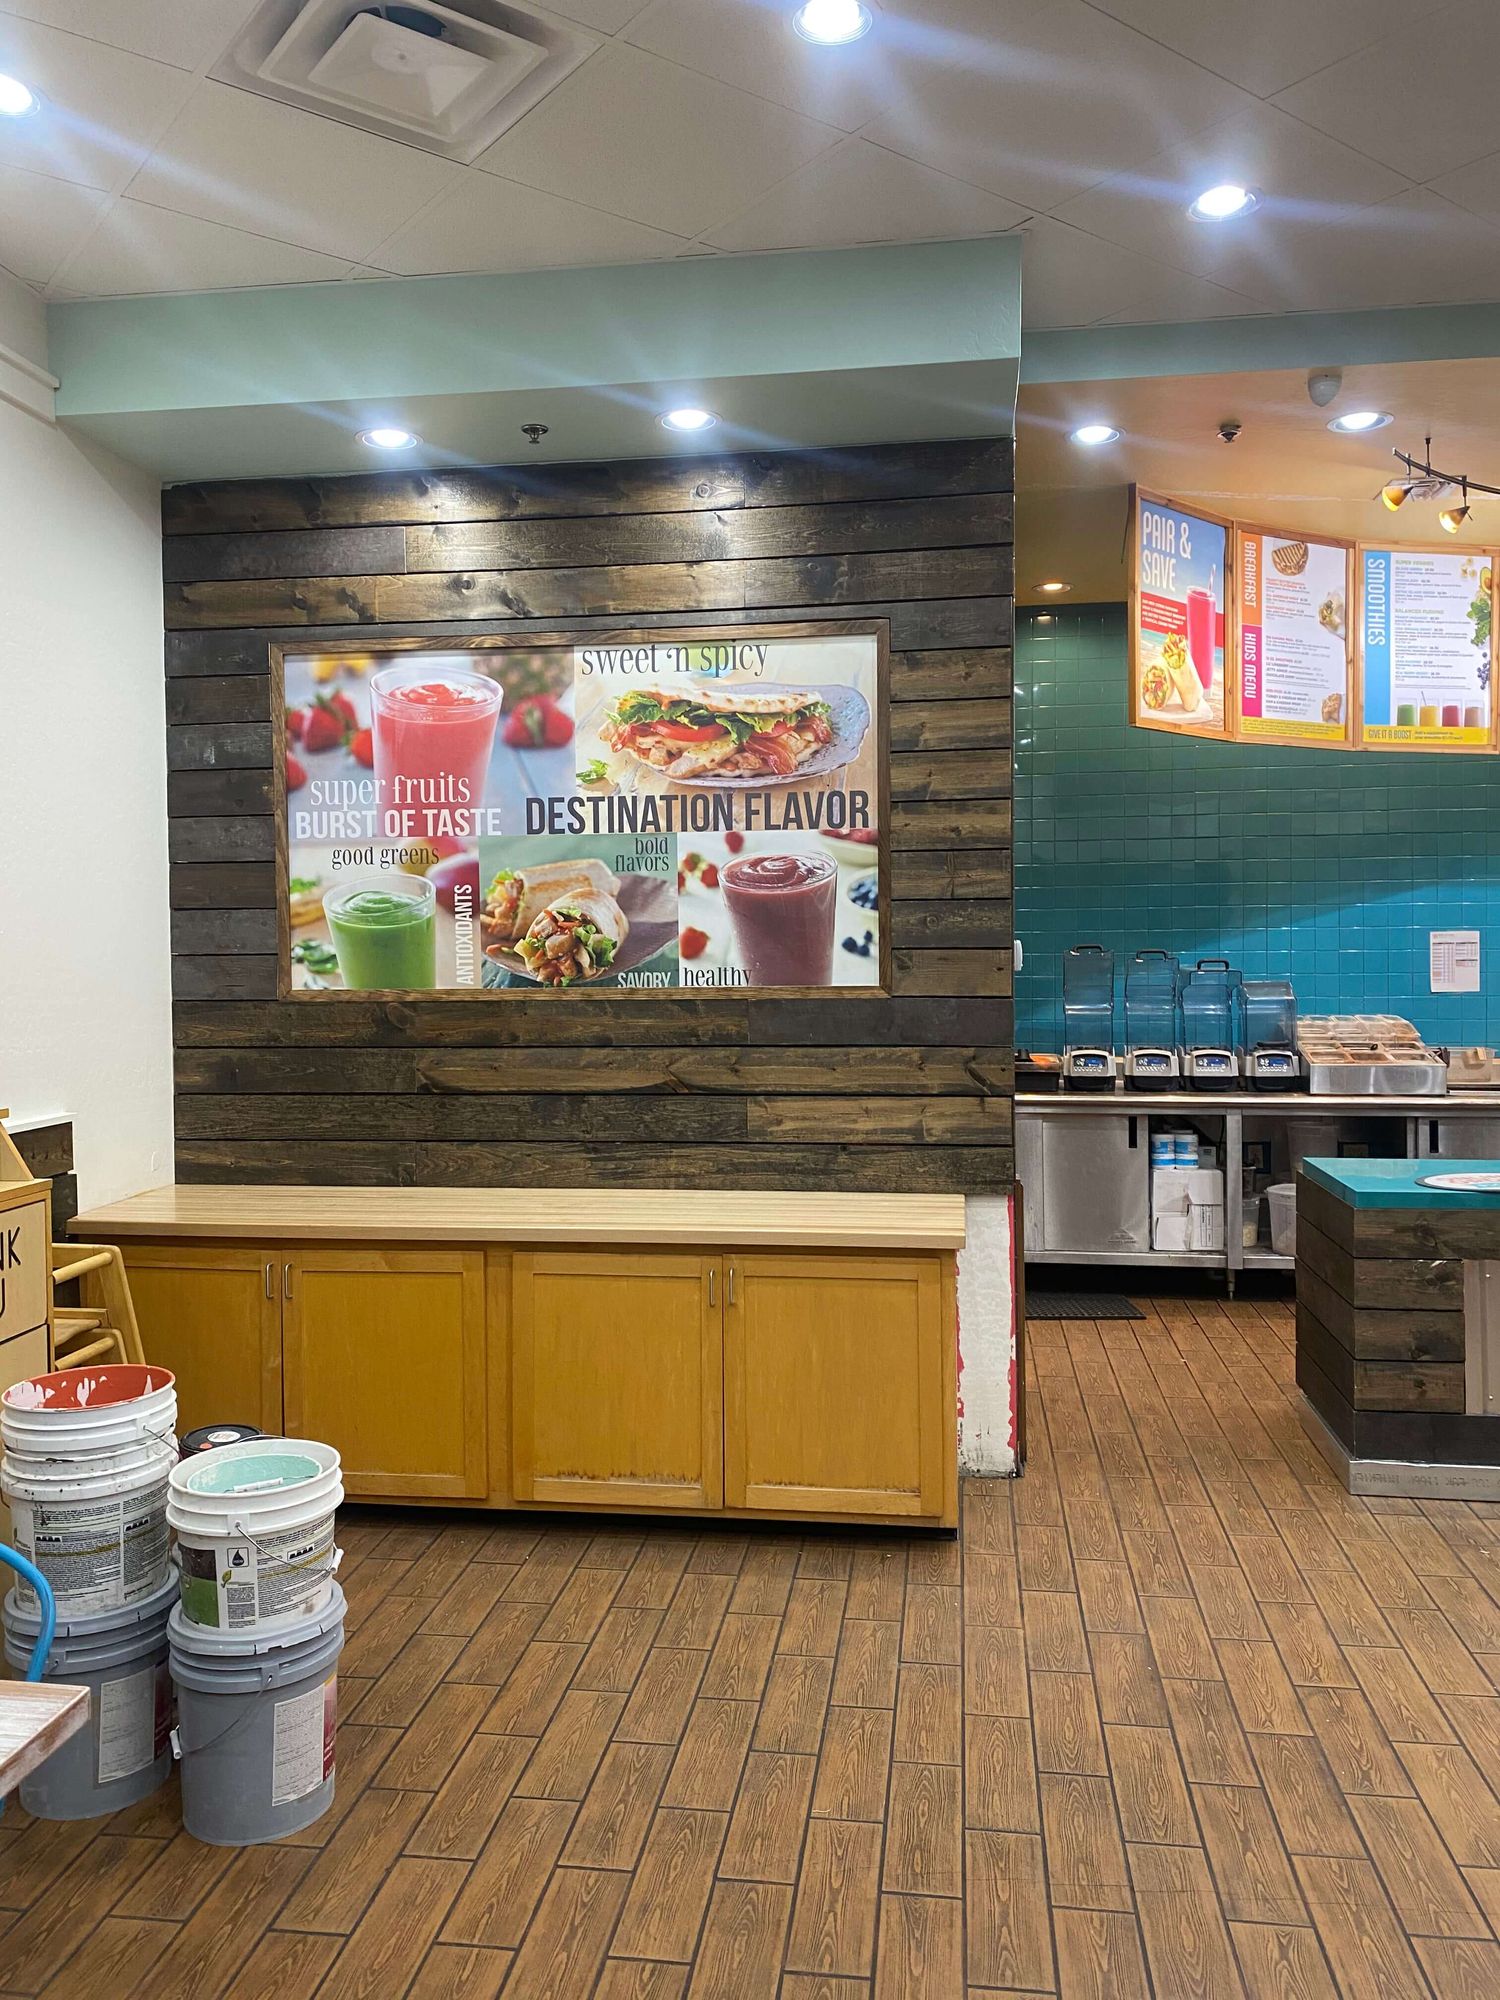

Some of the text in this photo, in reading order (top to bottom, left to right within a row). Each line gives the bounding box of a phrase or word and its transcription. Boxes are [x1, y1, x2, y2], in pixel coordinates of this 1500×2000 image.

[1143, 511, 1192, 560] PAIR &
[1143, 549, 1177, 592] SAVE
[1244, 541, 1257, 609] BREAKFAST
[1367, 558, 1386, 646] SMOOTHIES
[581, 644, 661, 676] sweet
[700, 639, 771, 679] spicy
[1244, 633, 1257, 699] KIDS MENU
[310, 771, 471, 812] super fruits
[295, 808, 502, 839] BURST OF TASTE
[525, 790, 869, 836] DESTINATION FLAVOR
[331, 846, 440, 870] good greens
[614, 854, 670, 873] flavors
[634, 836, 669, 856] bold
[453, 884, 475, 985] ANTIOXIDANTS
[617, 971, 672, 988] SAVORY
[683, 966, 752, 987] healthy
